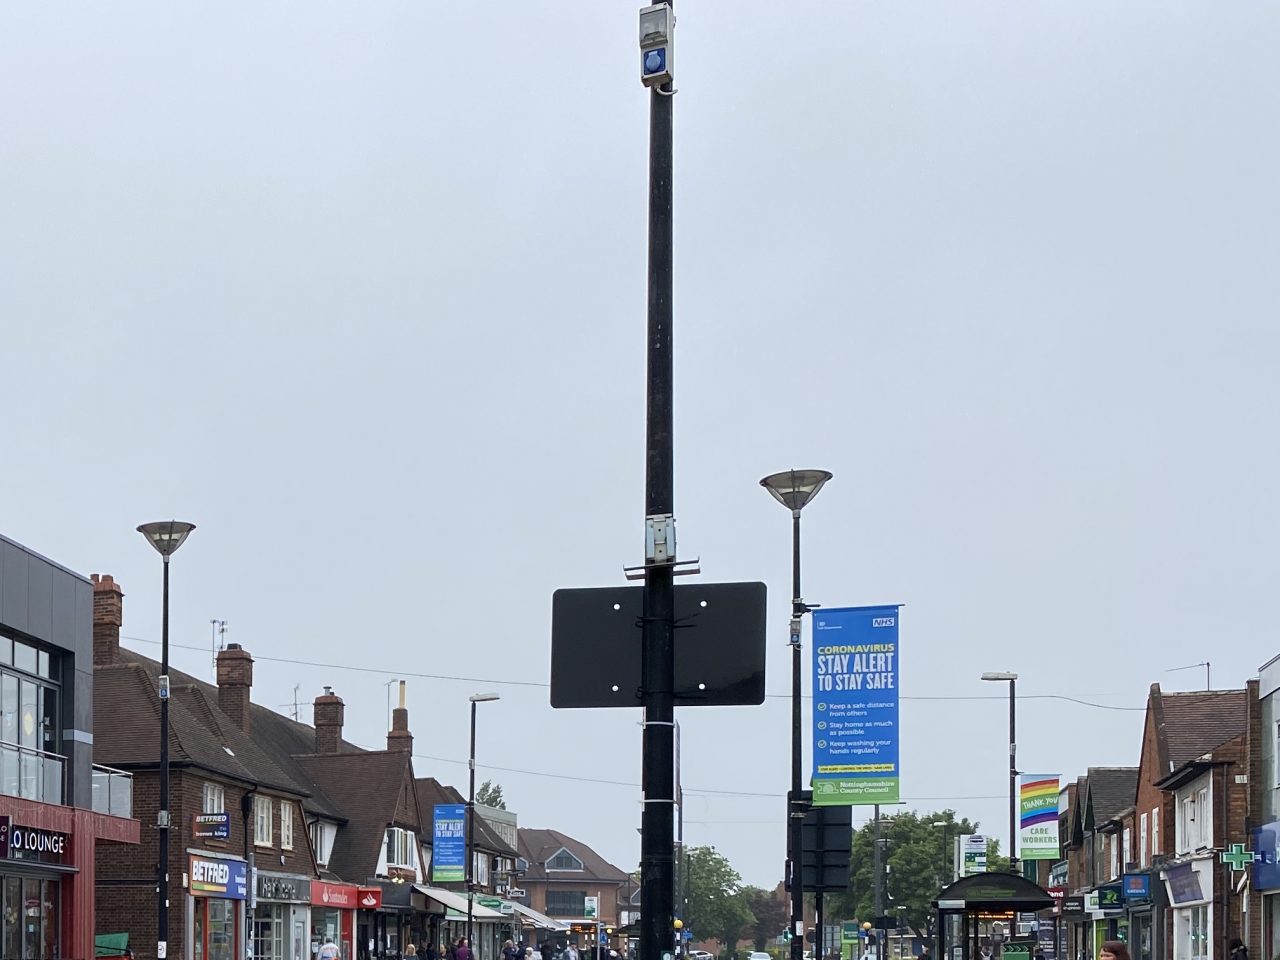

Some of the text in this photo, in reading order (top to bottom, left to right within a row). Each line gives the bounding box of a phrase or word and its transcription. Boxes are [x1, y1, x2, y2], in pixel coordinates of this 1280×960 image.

[874, 619, 893, 627] NHS
[817, 643, 895, 655] CORONAVIRUS
[817, 653, 894, 675] STAY ALERT
[818, 672, 895, 691] TO STAY SAFE
[829, 722, 843, 730] Stay
[838, 729, 865, 737] possible
[851, 747, 880, 755] regularly
[840, 781, 895, 789] Nottinghamshire
[840, 787, 864, 795] County
[1023, 796, 1058, 809] THANK YOU
[195, 815, 227, 823] BETFRED
[435, 822, 464, 831] STAY ALERT
[10, 830, 64, 854] O LOUNGE
[1022, 836, 1058, 844] WORKERS
[192, 860, 230, 885] BETFRED
